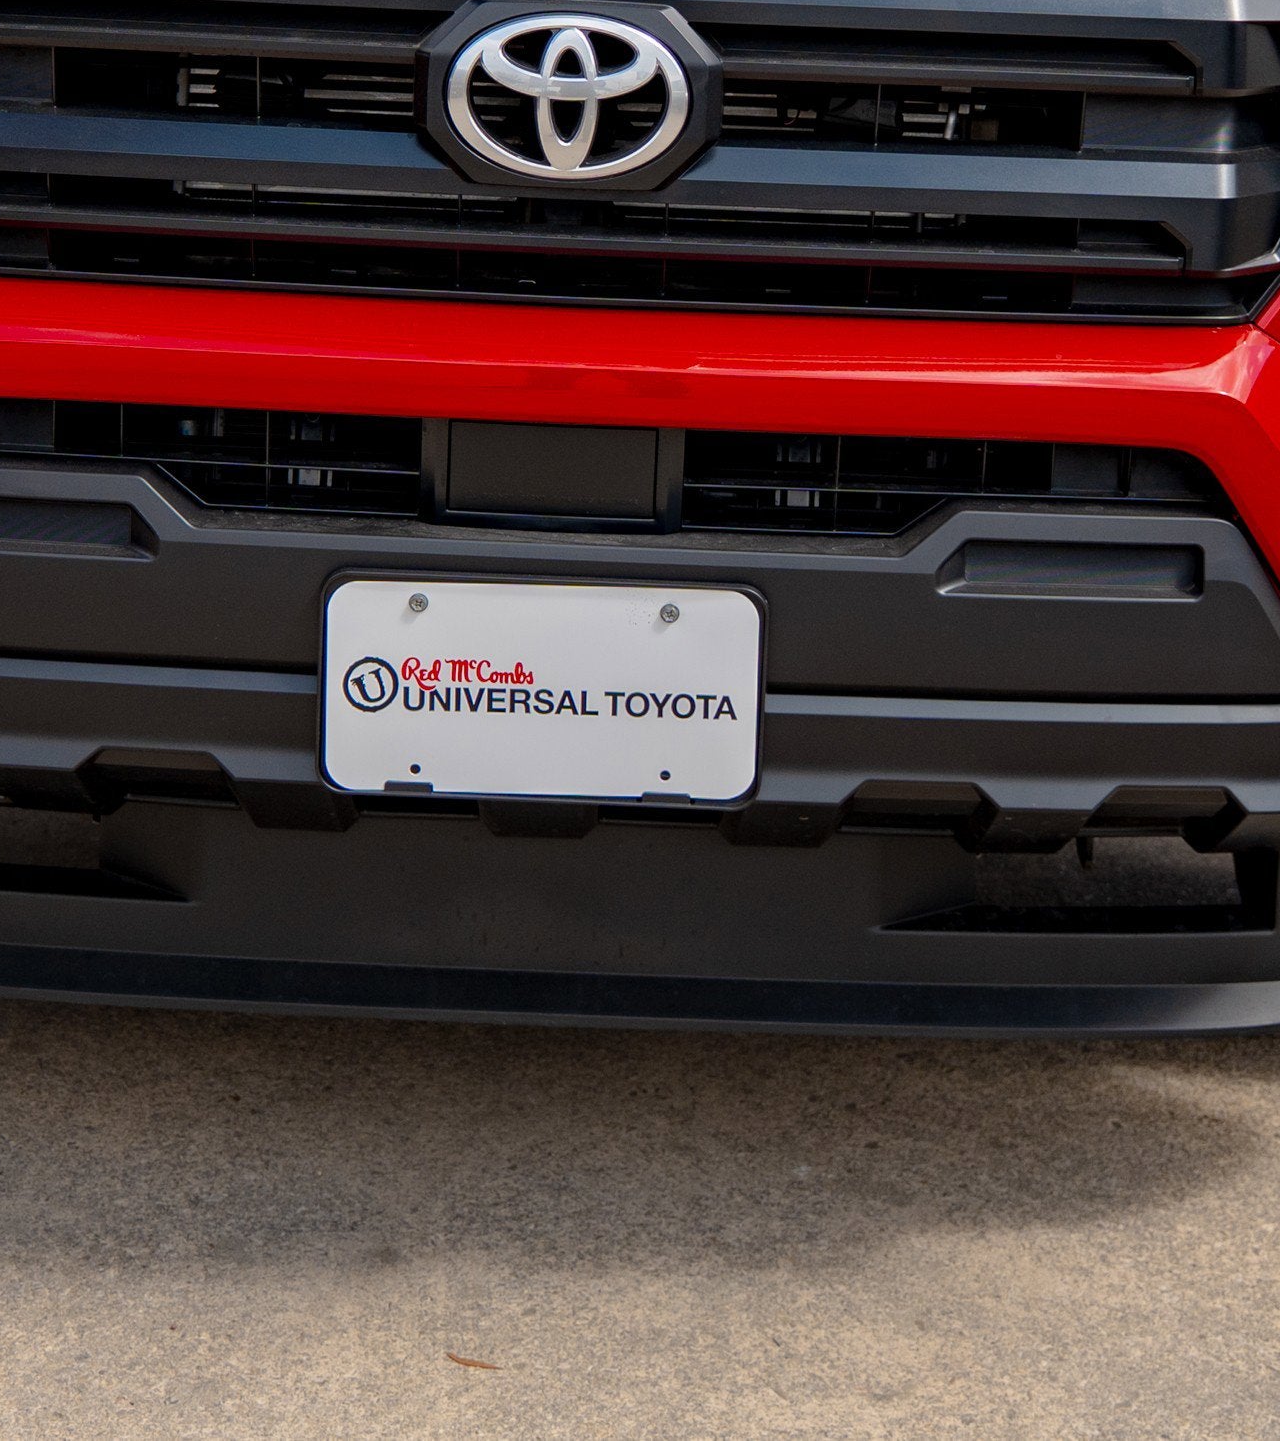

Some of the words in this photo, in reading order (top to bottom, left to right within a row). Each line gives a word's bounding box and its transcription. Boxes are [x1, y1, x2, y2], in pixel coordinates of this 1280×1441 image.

[401, 657, 441, 691] Red
[445, 658, 534, 685] McCombs
[402, 686, 599, 717] UNIVERSAL
[604, 691, 738, 721] TOYOTA
